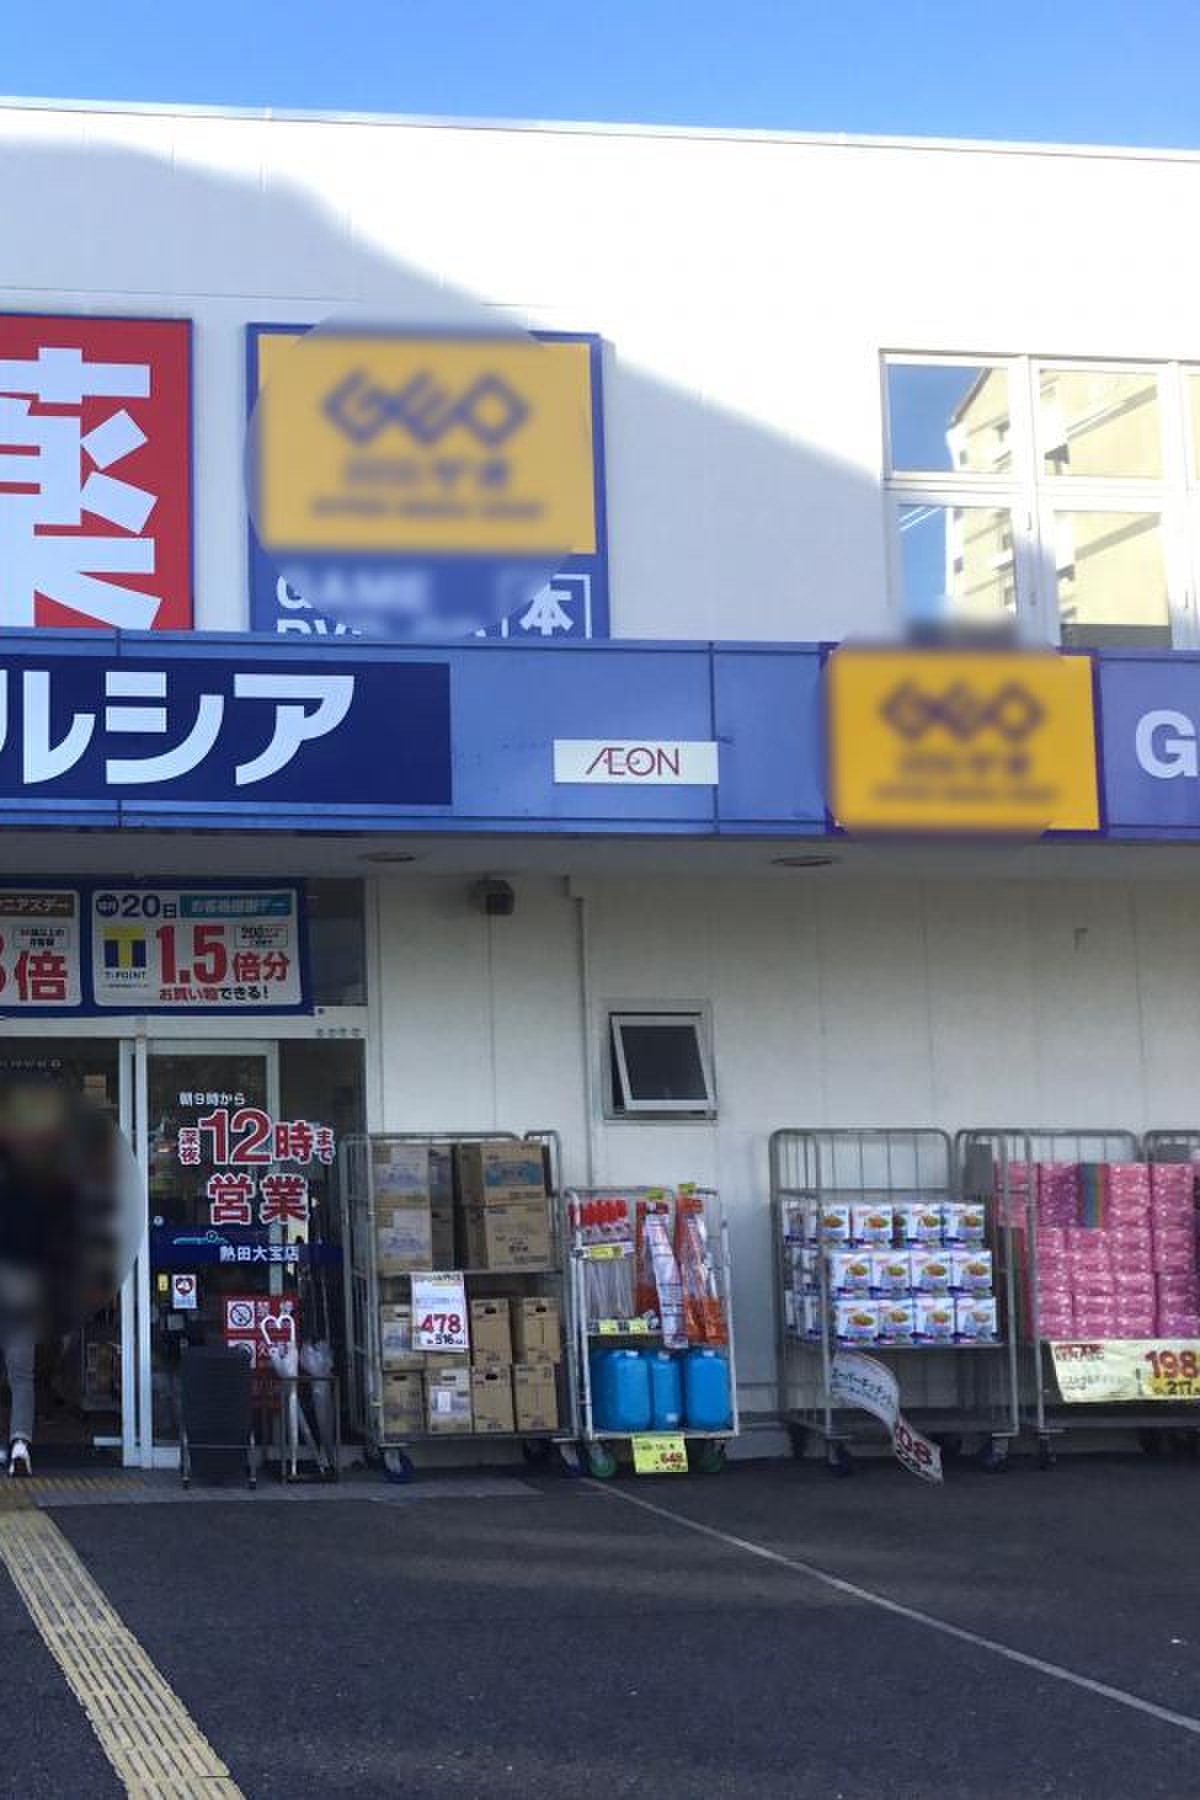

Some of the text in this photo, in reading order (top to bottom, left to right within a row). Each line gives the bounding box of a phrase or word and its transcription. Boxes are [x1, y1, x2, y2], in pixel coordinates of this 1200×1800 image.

[207, 1172, 310, 1226] 営業
[420, 1313, 462, 1334] 478
[1145, 1350, 1198, 1379] 198
